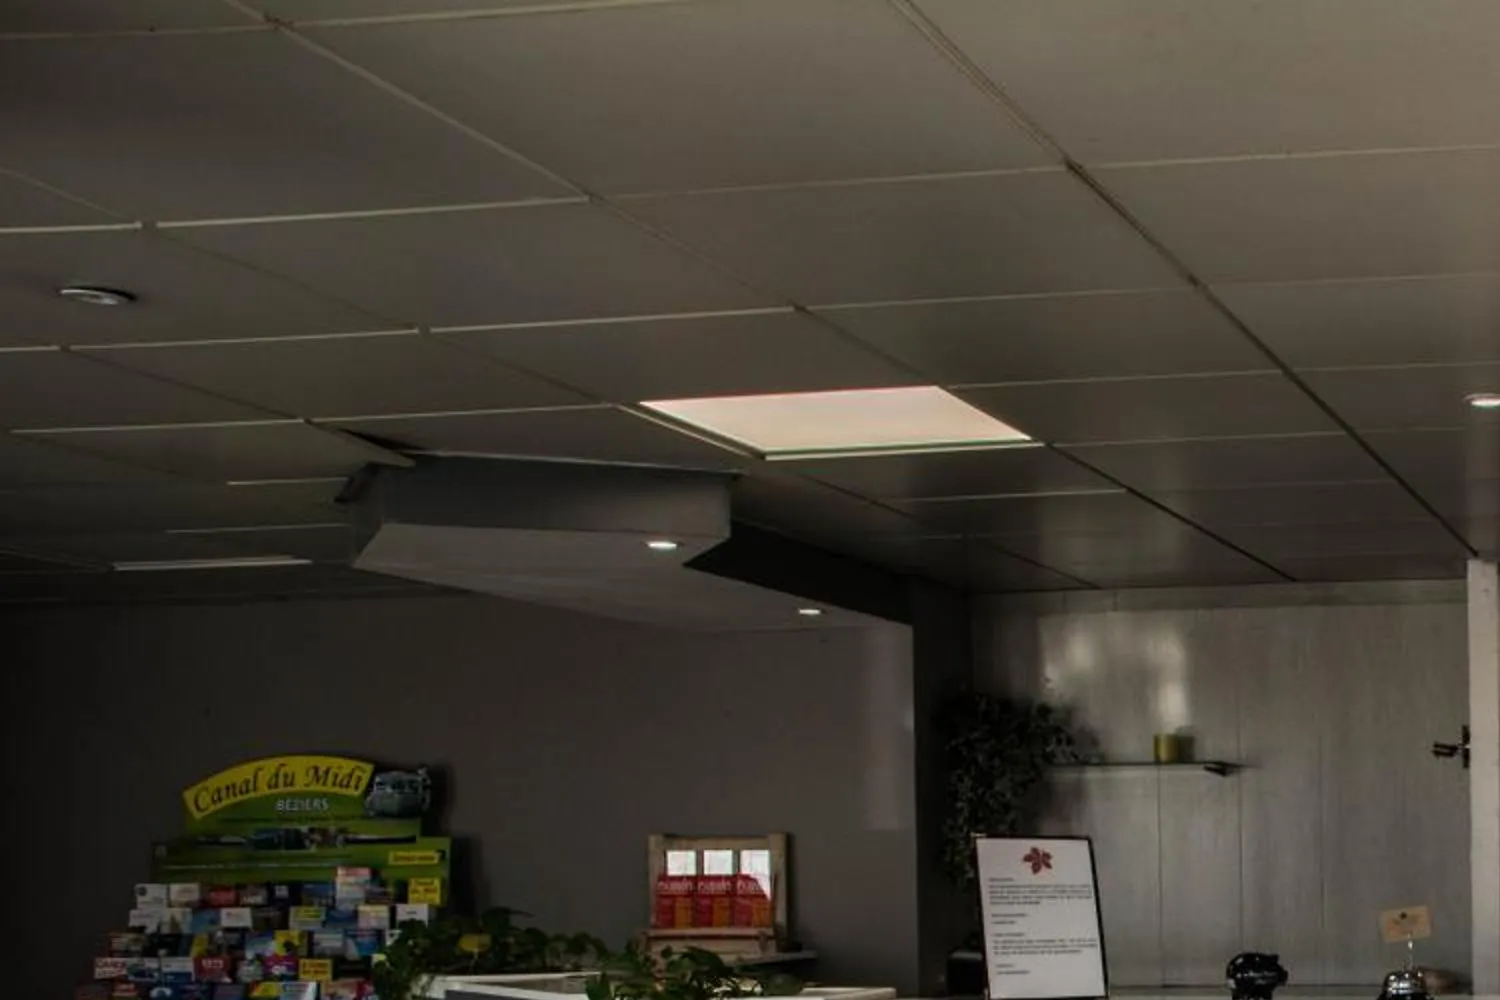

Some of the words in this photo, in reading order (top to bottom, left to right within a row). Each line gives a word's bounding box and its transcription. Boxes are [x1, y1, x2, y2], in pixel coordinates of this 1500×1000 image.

[193, 767, 261, 813] Canal
[267, 763, 295, 789] du
[305, 765, 363, 793] Midi
